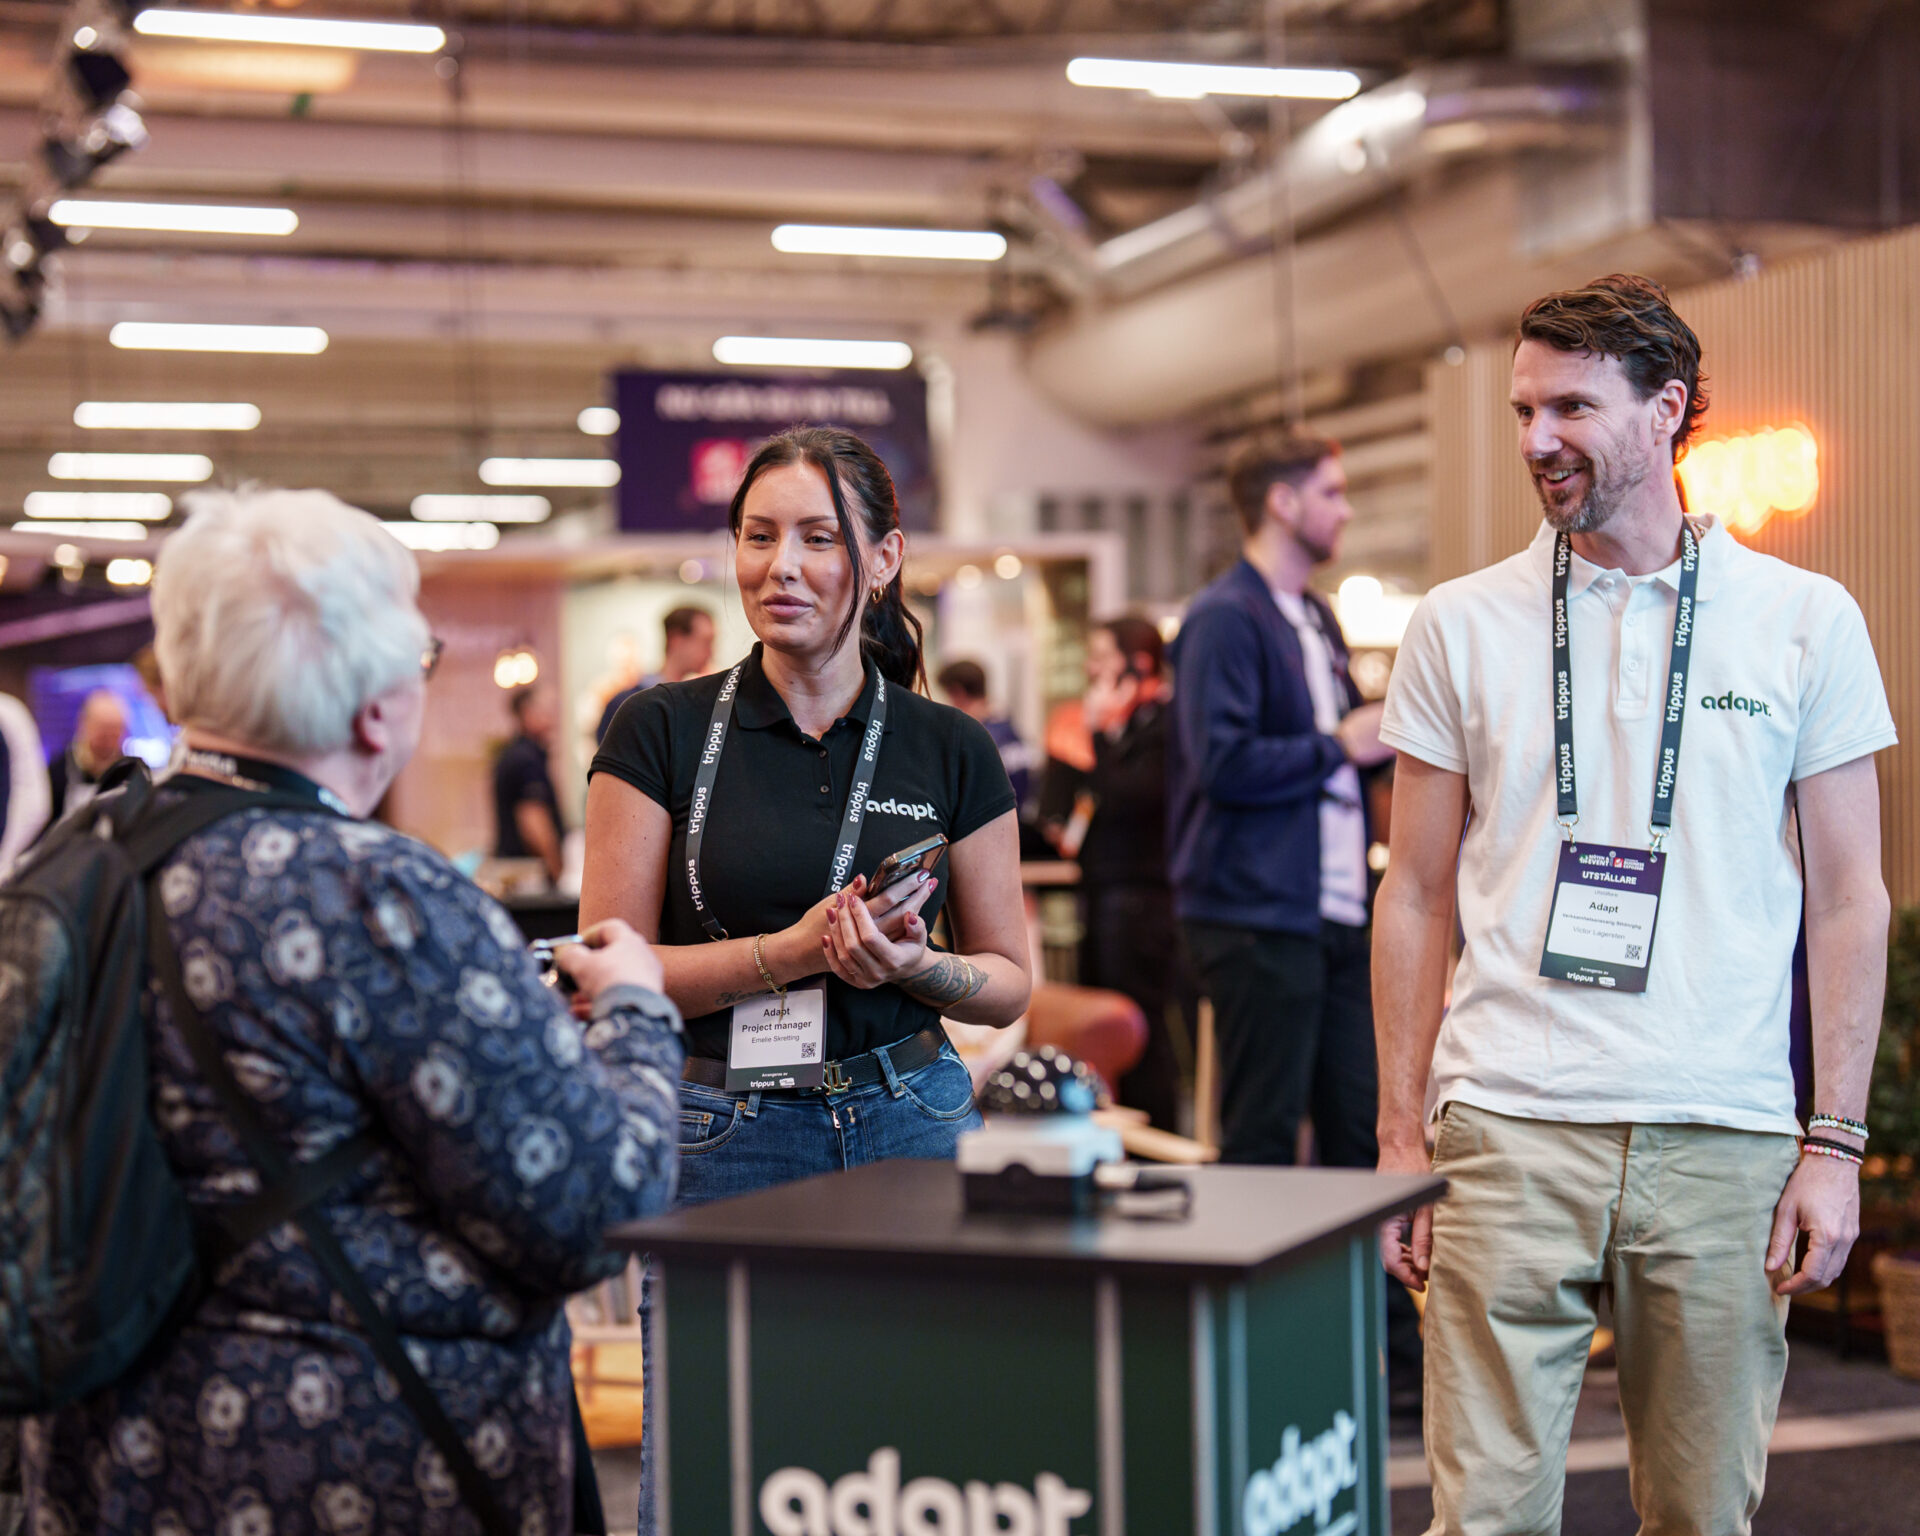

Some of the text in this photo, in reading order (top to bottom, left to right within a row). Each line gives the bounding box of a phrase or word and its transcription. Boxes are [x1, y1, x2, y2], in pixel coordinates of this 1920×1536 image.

[1683, 529, 1698, 572] trippus
[1554, 598, 1568, 649] trippus
[1675, 596, 1692, 648] trippus
[719, 665, 741, 702] trippus
[1556, 670, 1571, 721] trippus
[1666, 671, 1684, 723] trippus
[702, 722, 724, 765] trippus
[864, 719, 883, 762] trippus
[1559, 743, 1574, 794] trippus
[1656, 747, 1675, 799] trippus
[689, 786, 707, 835] trippus
[849, 781, 870, 823] trippus
[688, 858, 704, 911] trippus
[831, 843, 855, 893] trippus
[1582, 870, 1637, 885] UTSTÄLLARE
[1589, 901, 1619, 914] Adapt
[1567, 972, 1594, 983] trippus
[741, 1020, 813, 1034] Project manager
[751, 1036, 772, 1044] Emelie
[750, 1080, 775, 1089] trippus
